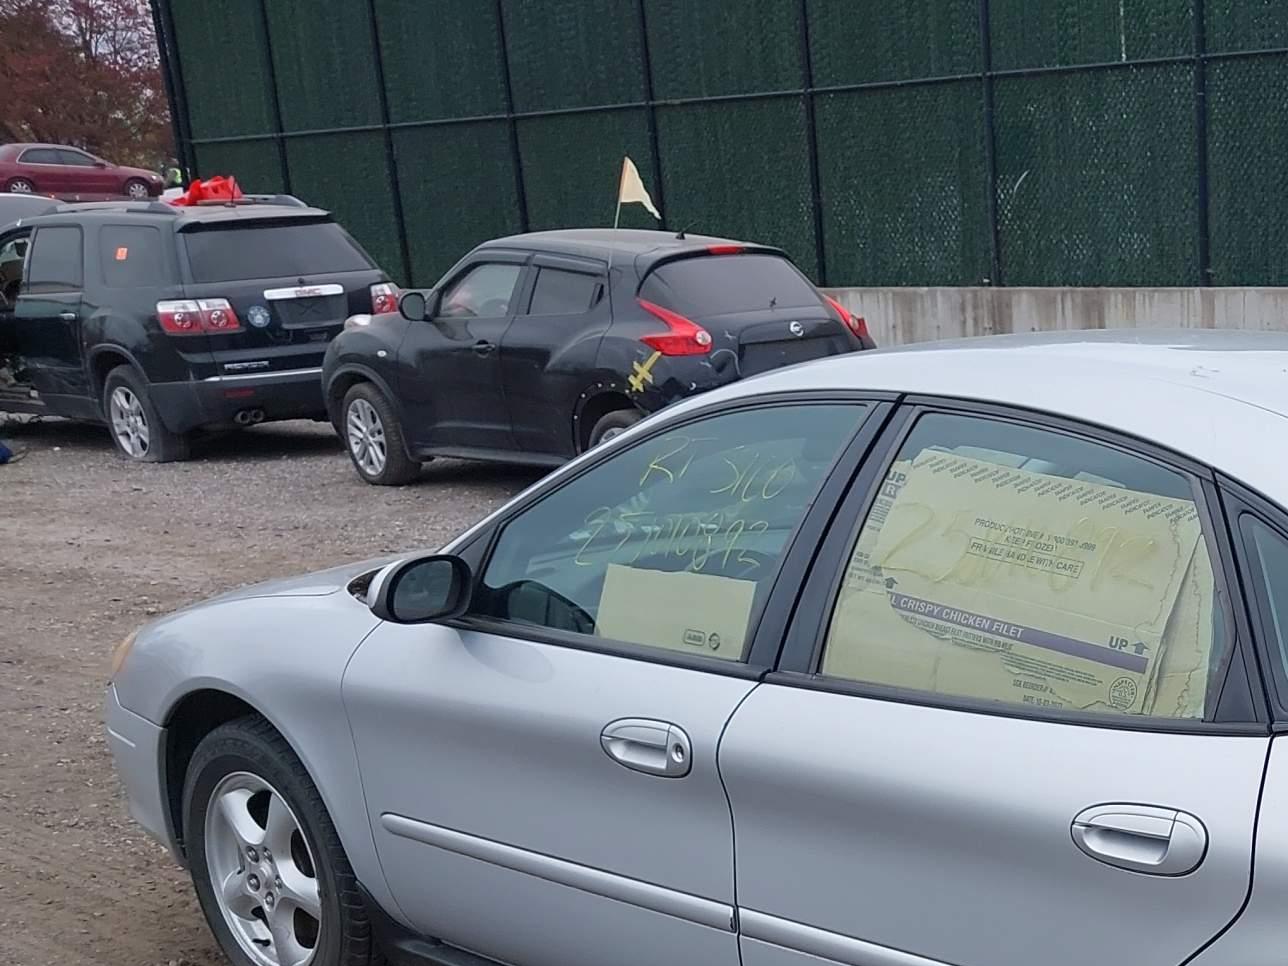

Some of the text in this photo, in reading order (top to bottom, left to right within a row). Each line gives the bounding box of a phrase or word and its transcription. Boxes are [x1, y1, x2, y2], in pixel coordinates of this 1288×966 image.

[1055, 561, 1080, 574] CARE
[900, 597, 941, 615] CRISPY
[942, 608, 990, 629] CHICKEN
[991, 621, 1025, 638] FILET
[1108, 636, 1129, 650] UP
